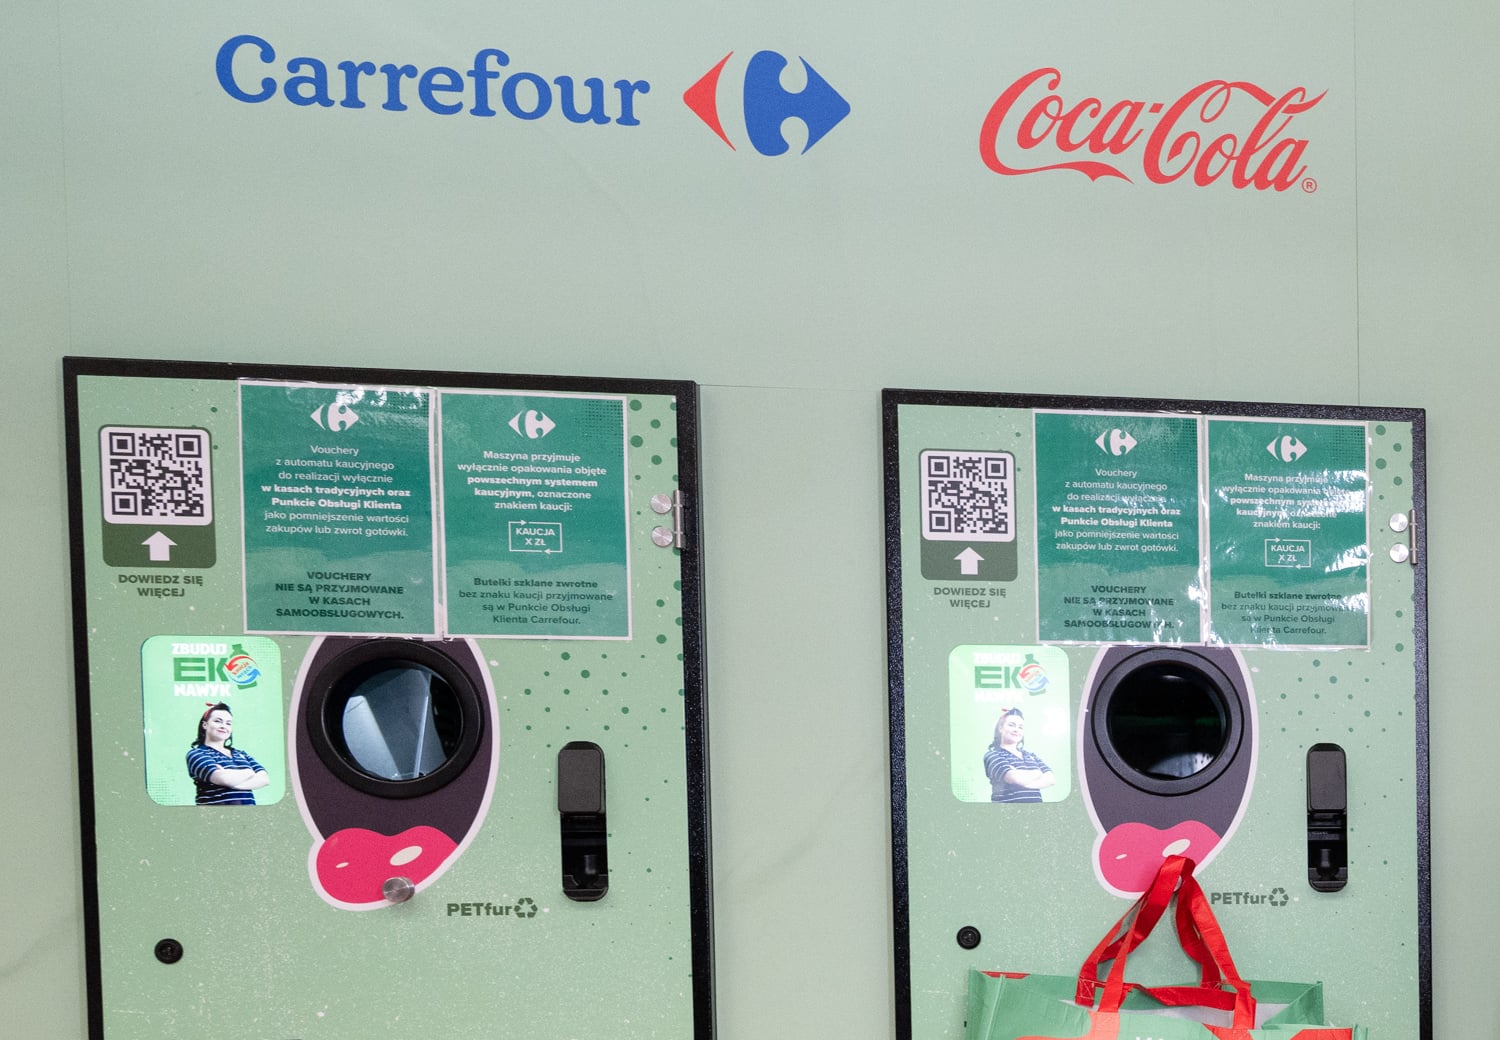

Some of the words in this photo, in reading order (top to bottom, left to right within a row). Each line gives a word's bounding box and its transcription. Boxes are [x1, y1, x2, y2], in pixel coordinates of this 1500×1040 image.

[215, 34, 651, 126] Carrefour
[311, 445, 359, 456] Vouchery
[483, 451, 528, 461] Maszyna
[531, 453, 581, 463] przyjmuje
[285, 458, 333, 468] automatu
[336, 460, 394, 470] kaucyjnego
[458, 463, 508, 473] wyłącznie
[511, 465, 572, 475] opakowania
[575, 467, 606, 476] objęte
[279, 472, 291, 480] do
[295, 472, 339, 482] realizacji
[343, 474, 393, 483] wyłącznie
[1095, 468, 1137, 479] Vouchery
[467, 477, 542, 486] powszechnym
[545, 479, 597, 488] systemem
[274, 485, 312, 493] kasach
[315, 486, 384, 497] tradycyjnych
[474, 488, 535, 499] kaucyjnym,
[272, 498, 315, 507] Punkcie
[319, 499, 361, 510] Obsługi
[364, 501, 402, 510] Klienta
[495, 501, 537, 510] znakiem
[540, 502, 573, 512] kaucji:
[1063, 505, 1096, 513] kasach
[1099, 506, 1158, 516] tradycyjnych
[264, 511, 286, 521] jako
[289, 513, 364, 523] pomniejszenie
[367, 514, 409, 523] wartości
[1061, 517, 1099, 526] Punkcie
[1101, 518, 1138, 528] Obsługi
[1140, 519, 1173, 528] Klienta
[266, 525, 312, 534] zakupów
[315, 526, 331, 534] lub
[334, 527, 362, 535] zwrot
[365, 527, 408, 537] gotówki.
[1253, 521, 1290, 529] znakiem
[1293, 521, 1321, 530] kaucji:
[515, 528, 555, 536] KAUCJA
[535, 538, 546, 546] ZŁ
[118, 574, 180, 585] DOWIEDZ
[183, 575, 203, 586] SIĘ
[307, 572, 371, 580] VOUCHERY
[474, 578, 511, 586] Butelki
[514, 579, 553, 588] szklane
[556, 580, 598, 588] zwrotne
[137, 588, 185, 598] WIĘCEJ
[276, 584, 294, 592] NIE
[297, 584, 313, 593] SĄ
[316, 585, 404, 594] PRZYJMOWANE
[933, 587, 987, 597] DOWIEDZ
[989, 588, 1007, 598] SIĘ
[1092, 585, 1146, 594] VOUCHERY
[323, 597, 370, 605] KASACH
[459, 590, 477, 598] bez
[480, 591, 510, 599] znaku
[513, 592, 543, 601] kaucji
[546, 592, 613, 602] przyjmowane
[482, 604, 493, 612] są
[508, 603, 548, 611] Punkcie
[551, 604, 590, 614] Obsługi
[950, 599, 990, 609] WIĘCEJ
[276, 608, 404, 619] SAMOOBSŁUGOWYCH.
[493, 616, 528, 624] Klienta
[531, 617, 581, 625] Carrefour.
[174, 684, 231, 696] NAWYK
[1211, 892, 1267, 905] PETfur
[447, 902, 512, 916] PETfur
